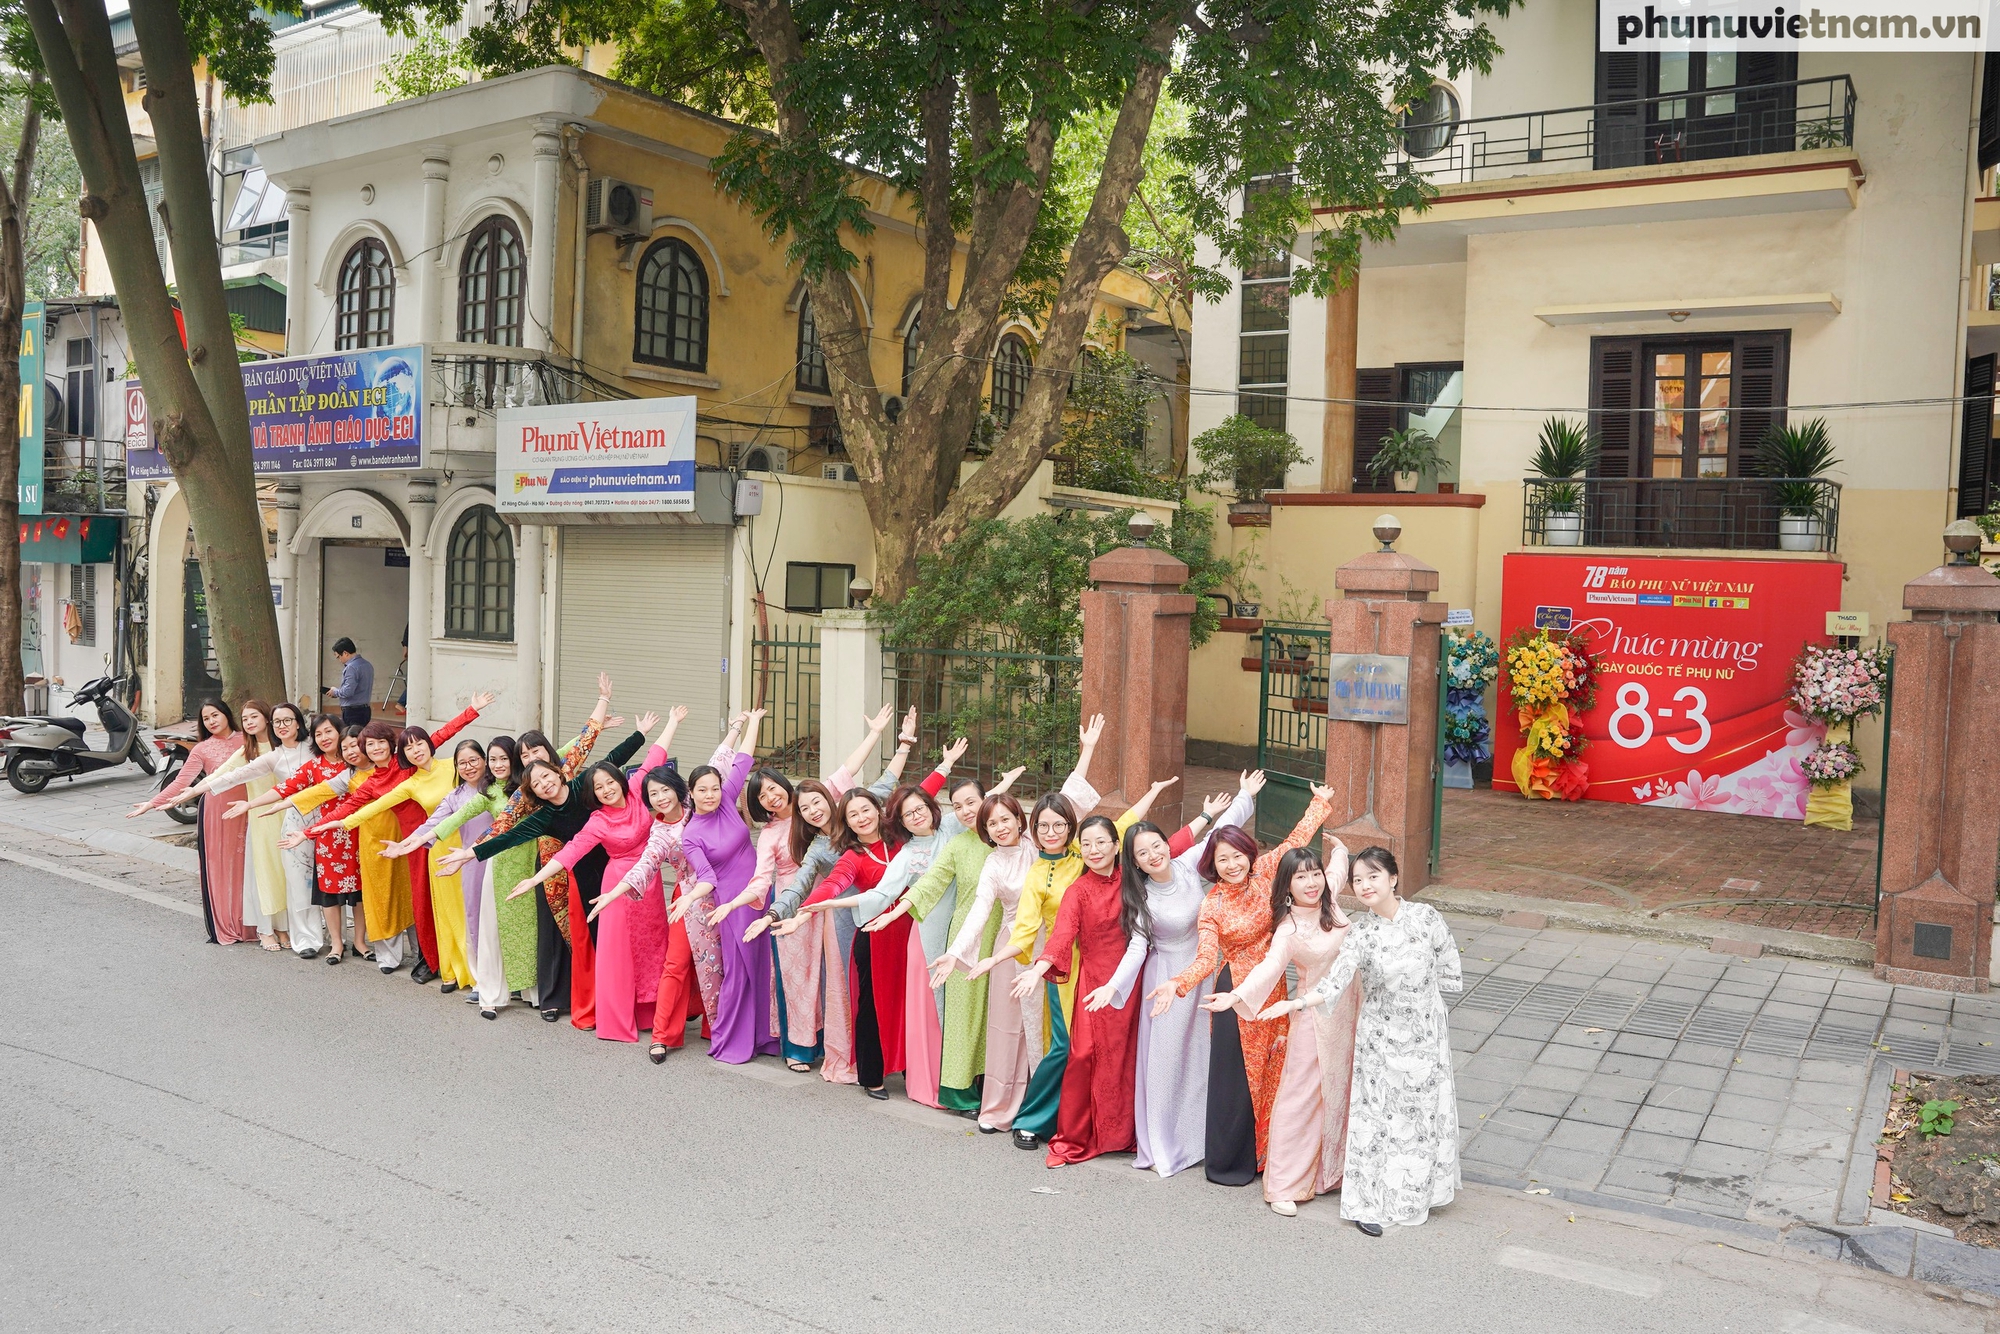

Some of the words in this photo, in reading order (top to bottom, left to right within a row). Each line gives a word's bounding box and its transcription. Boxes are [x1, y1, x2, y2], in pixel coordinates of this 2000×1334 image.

[244, 368, 263, 387] BẢN
[264, 366, 287, 385] GIÁO
[289, 366, 309, 385] DỤC
[310, 361, 333, 383] VIỆT
[334, 361, 357, 377] NAM
[249, 390, 287, 416] PHẦN
[289, 389, 316, 418] TẬP
[318, 385, 360, 411] ĐOÀN
[362, 386, 388, 407] ECI
[127, 438, 147, 447] ECICO
[253, 422, 268, 449] VÀ
[269, 422, 305, 448] TRANH
[307, 415, 332, 446] ẢNH
[334, 415, 362, 444] GIÁO
[365, 416, 390, 447] DỤC
[392, 415, 414, 440] ECI
[303, 458, 312, 468] 024
[589, 473, 681, 488] phunuvietnam.vn
[1582, 565, 1609, 588] 78
[1608, 566, 1629, 576] năm
[1609, 578, 1636, 590] BÁO
[1638, 579, 1668, 594] PHỤ
[1669, 578, 1691, 591] NỮ
[1692, 578, 1723, 595] VIỆT
[1722, 582, 1755, 594] NAM
[1566, 617, 1665, 657] Chúc
[1669, 635, 1764, 671] mừng
[1626, 661, 1663, 676] QUỐC
[1667, 664, 1683, 677] TẾ
[1686, 667, 1712, 681] PHỤ
[1715, 667, 1735, 680] NỮ
[1608, 682, 1711, 754] 8-3
